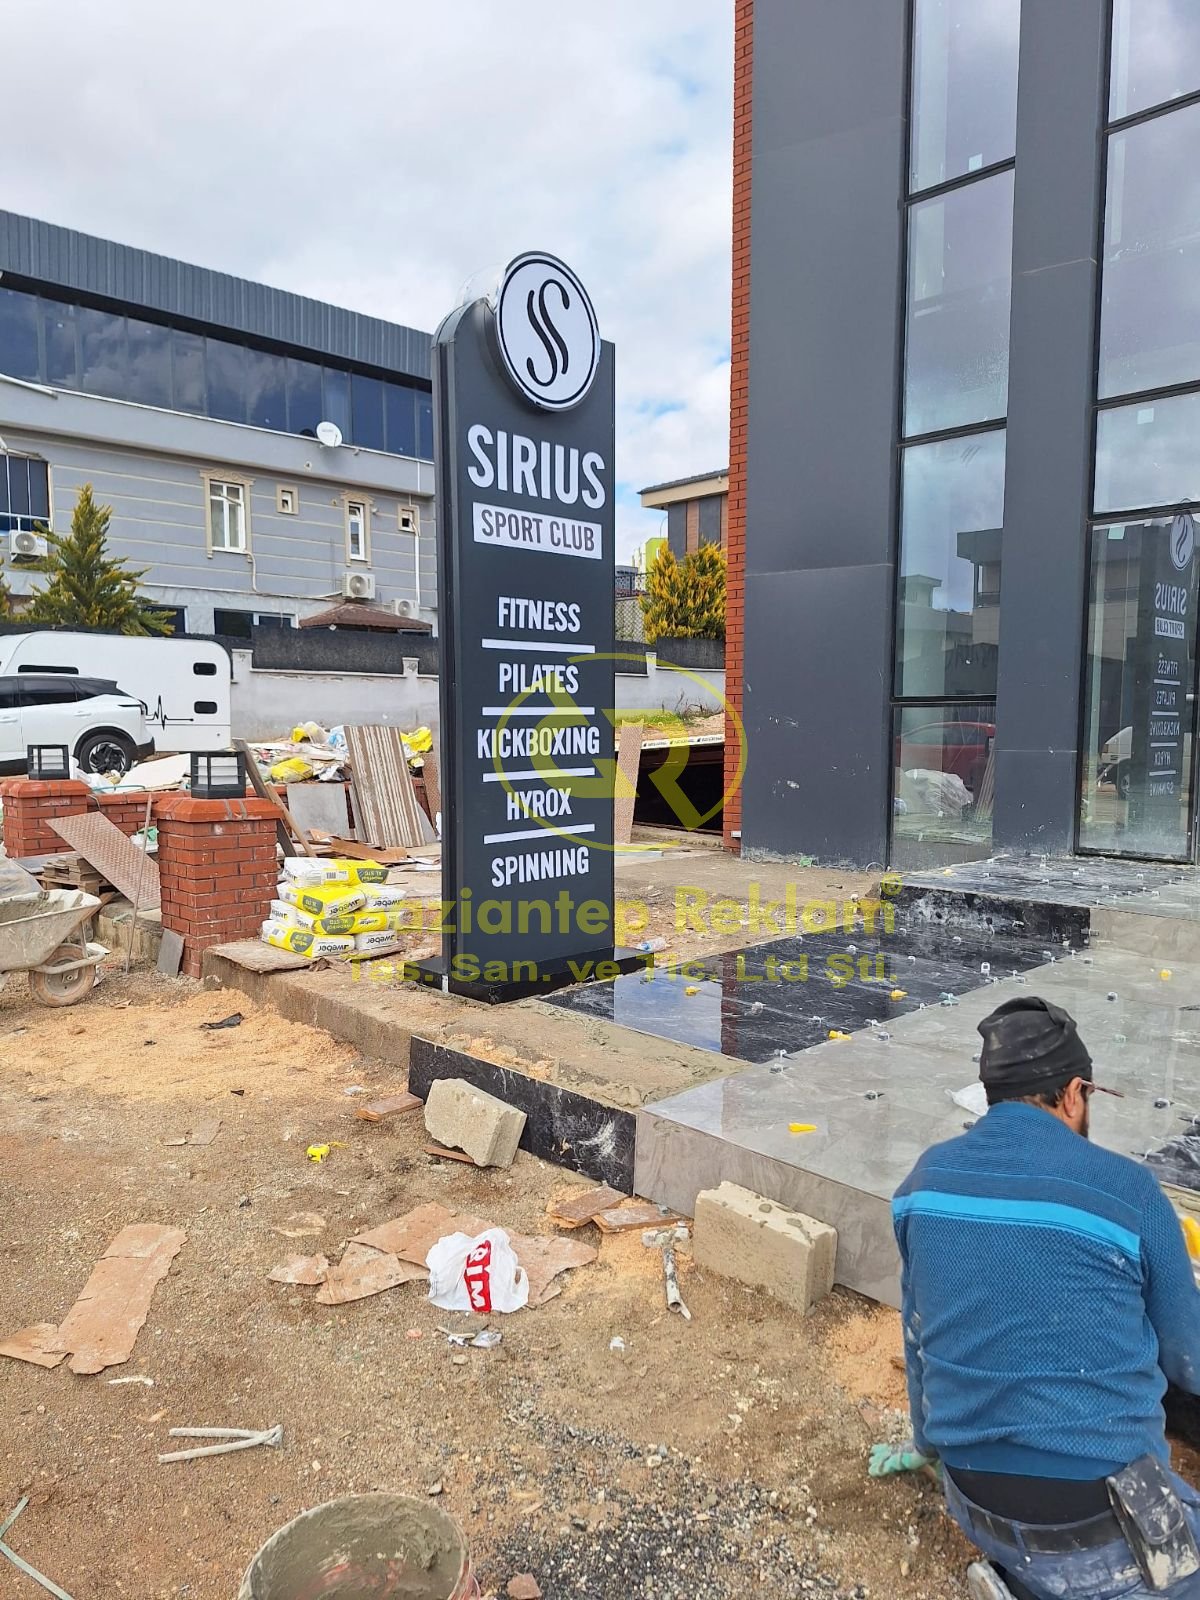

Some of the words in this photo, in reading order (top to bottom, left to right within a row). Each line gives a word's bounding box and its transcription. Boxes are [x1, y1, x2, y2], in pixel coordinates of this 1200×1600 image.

[467, 424, 606, 510] SIRIUS
[482, 509, 543, 544] SPORT
[549, 520, 595, 551] CLUB
[498, 596, 581, 634] FITNESS
[498, 662, 579, 695] PILATES
[477, 725, 600, 760] KICKBOXING
[506, 787, 573, 822] HYROX
[490, 845, 590, 888] SPINNING
[329, 900, 356, 915] weber
[373, 899, 399, 909] weber
[318, 944, 344, 953] weber
[366, 935, 391, 945] weber
